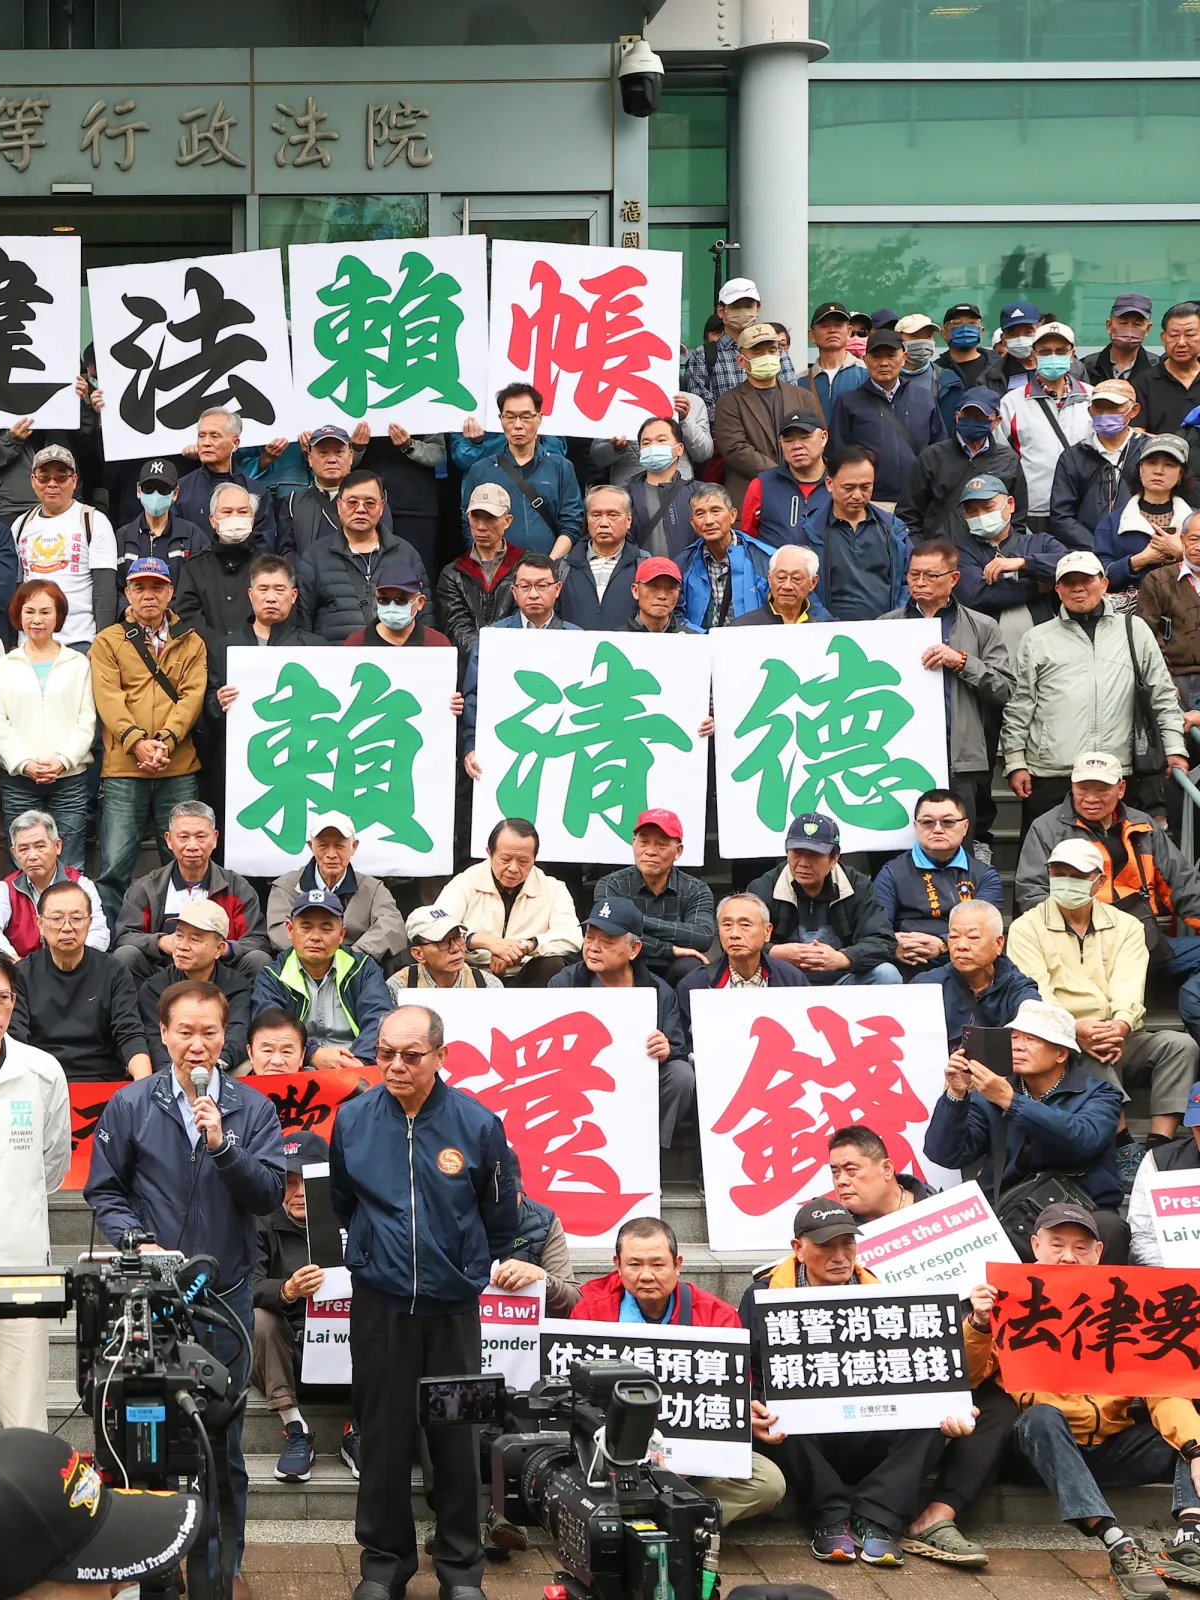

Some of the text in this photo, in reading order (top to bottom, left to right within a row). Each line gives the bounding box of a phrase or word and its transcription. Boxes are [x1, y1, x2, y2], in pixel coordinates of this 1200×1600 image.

[429, 908, 449, 919] CIA
[1158, 1195, 1200, 1211] Pres
[856, 1202, 984, 1268] gnores the law!
[1163, 1226, 1189, 1243] Lai
[885, 1232, 999, 1285] first responder
[313, 1300, 352, 1312] Pres
[497, 1301, 537, 1320] law!
[764, 1303, 958, 1347] 護警消尊嚴!
[306, 1329, 331, 1344] Lai
[481, 1337, 538, 1352] ponder
[768, 1347, 965, 1391] 賴清德還錢!
[77, 1567, 110, 1580] ROCAF
[111, 1560, 147, 1581] Special
[146, 1532, 188, 1570] Transport
